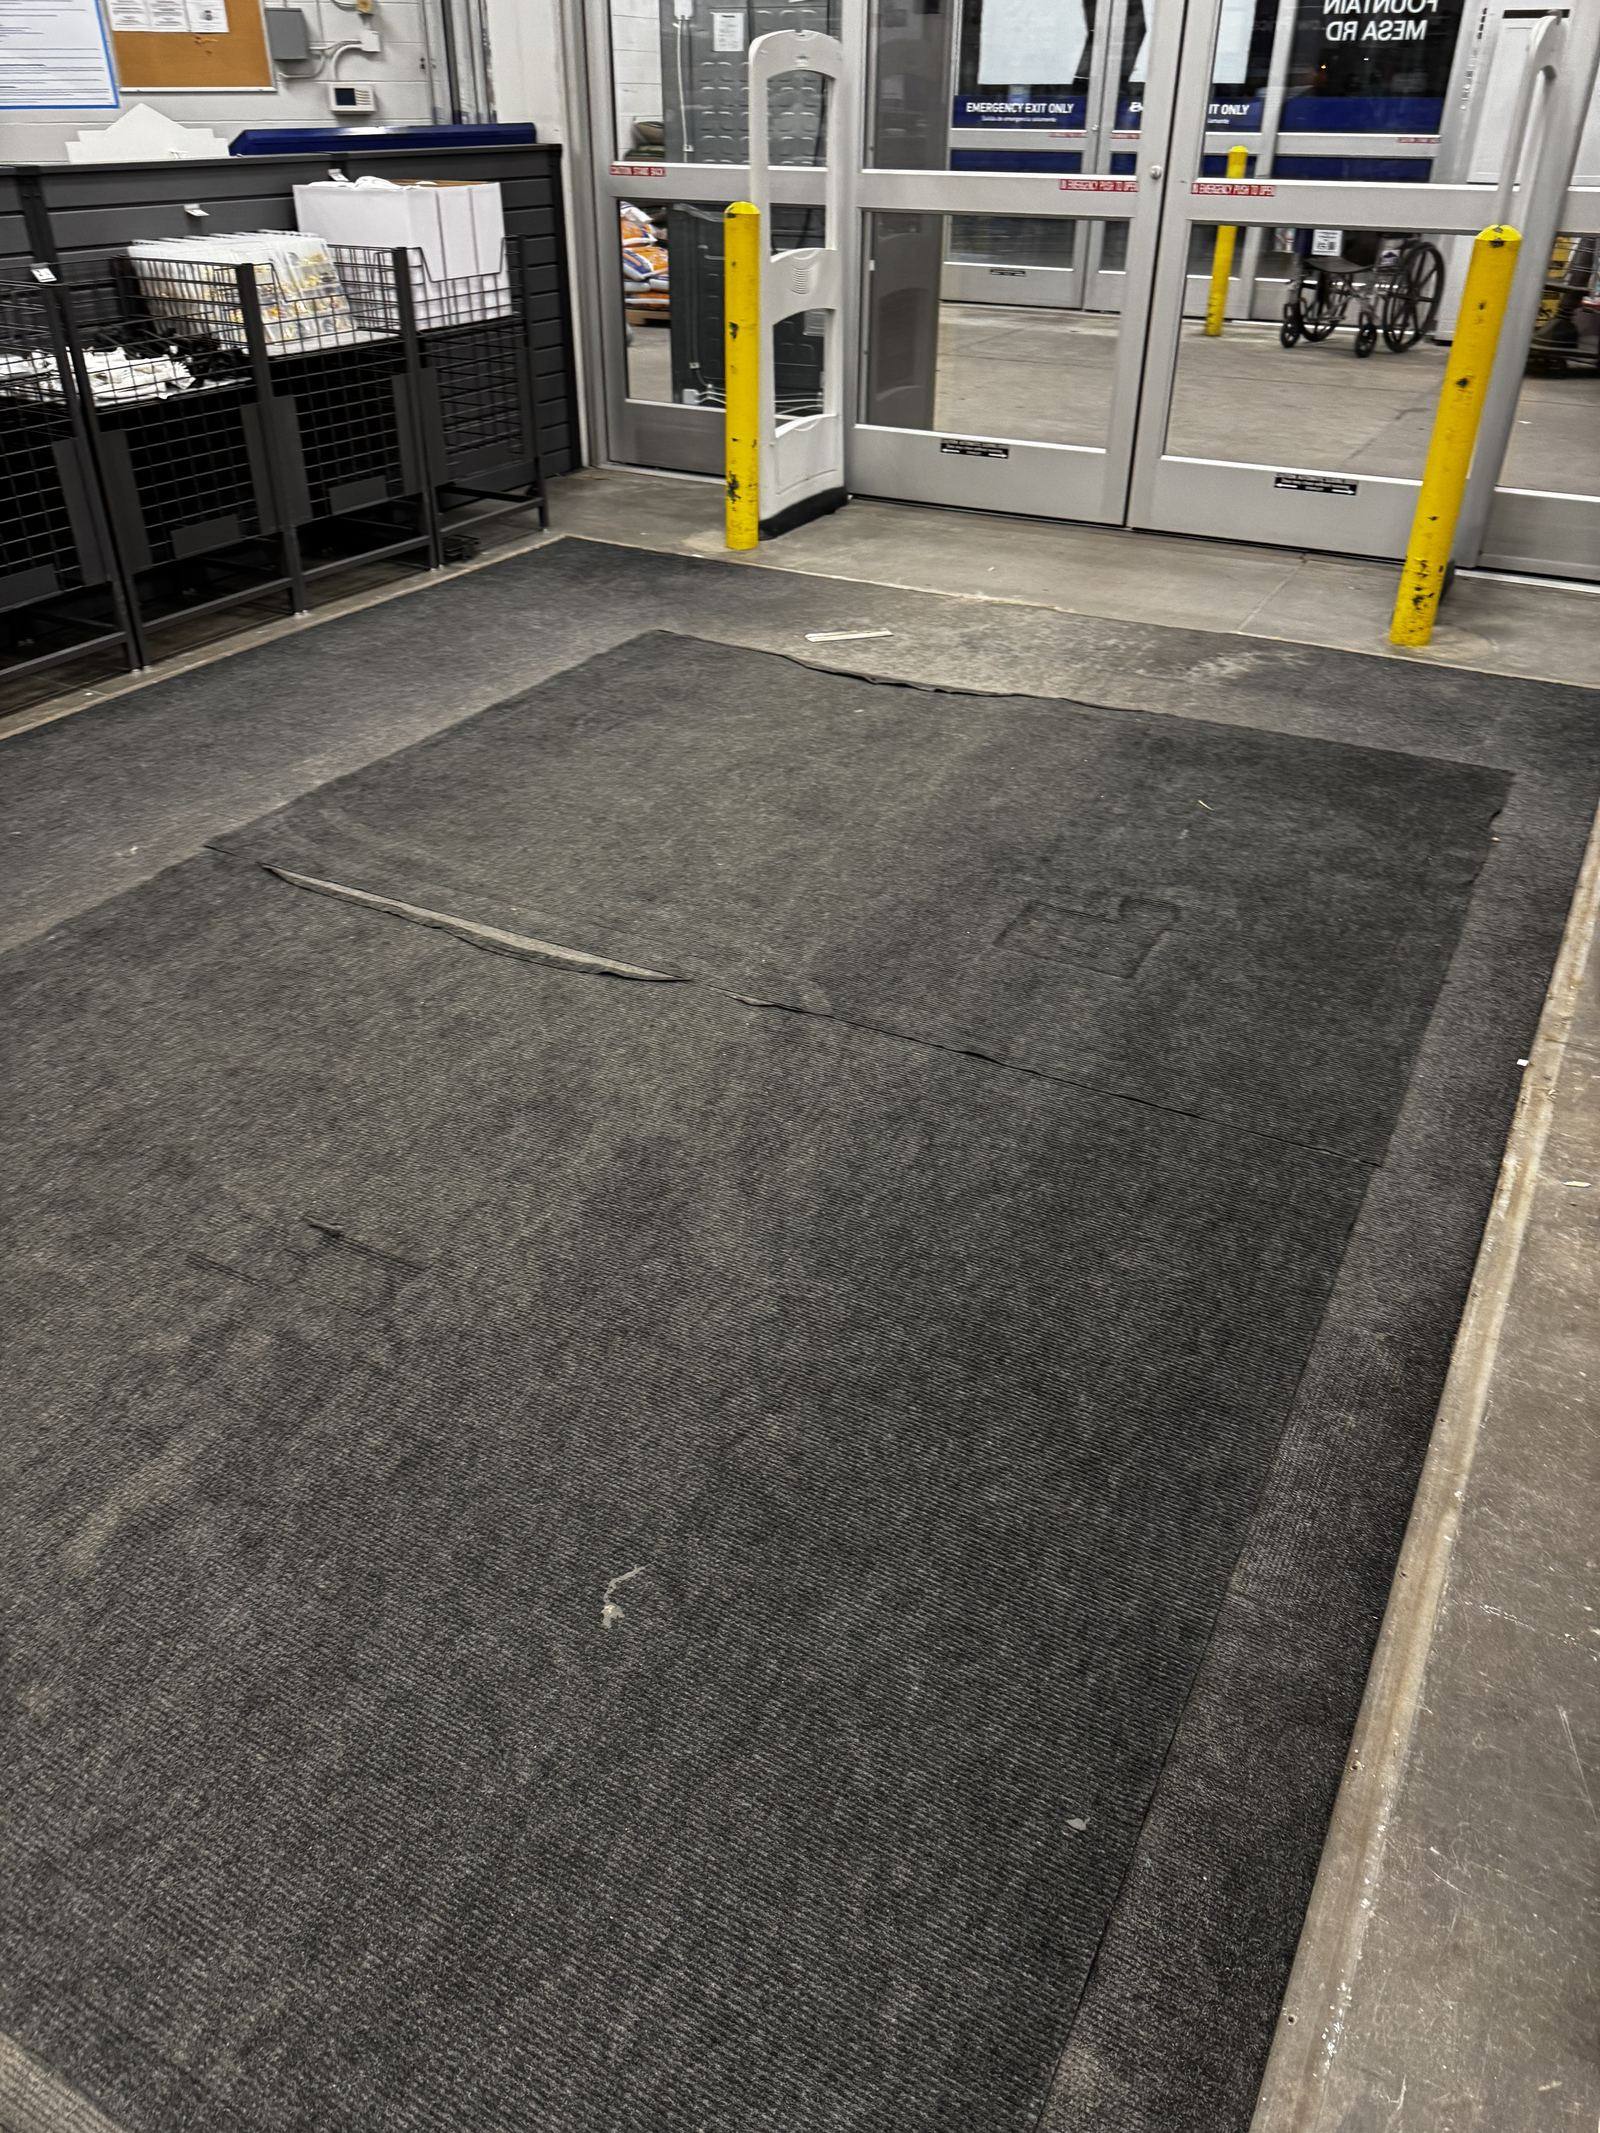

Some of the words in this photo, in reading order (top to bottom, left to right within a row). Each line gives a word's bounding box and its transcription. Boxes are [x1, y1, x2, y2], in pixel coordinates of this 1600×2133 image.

[966, 102, 1024, 113] EMERGENCY
[1025, 103, 1048, 113] EXIT
[1048, 103, 1075, 114] ONLY
[1207, 104, 1219, 114] IT
[1220, 104, 1250, 115] ONLY
